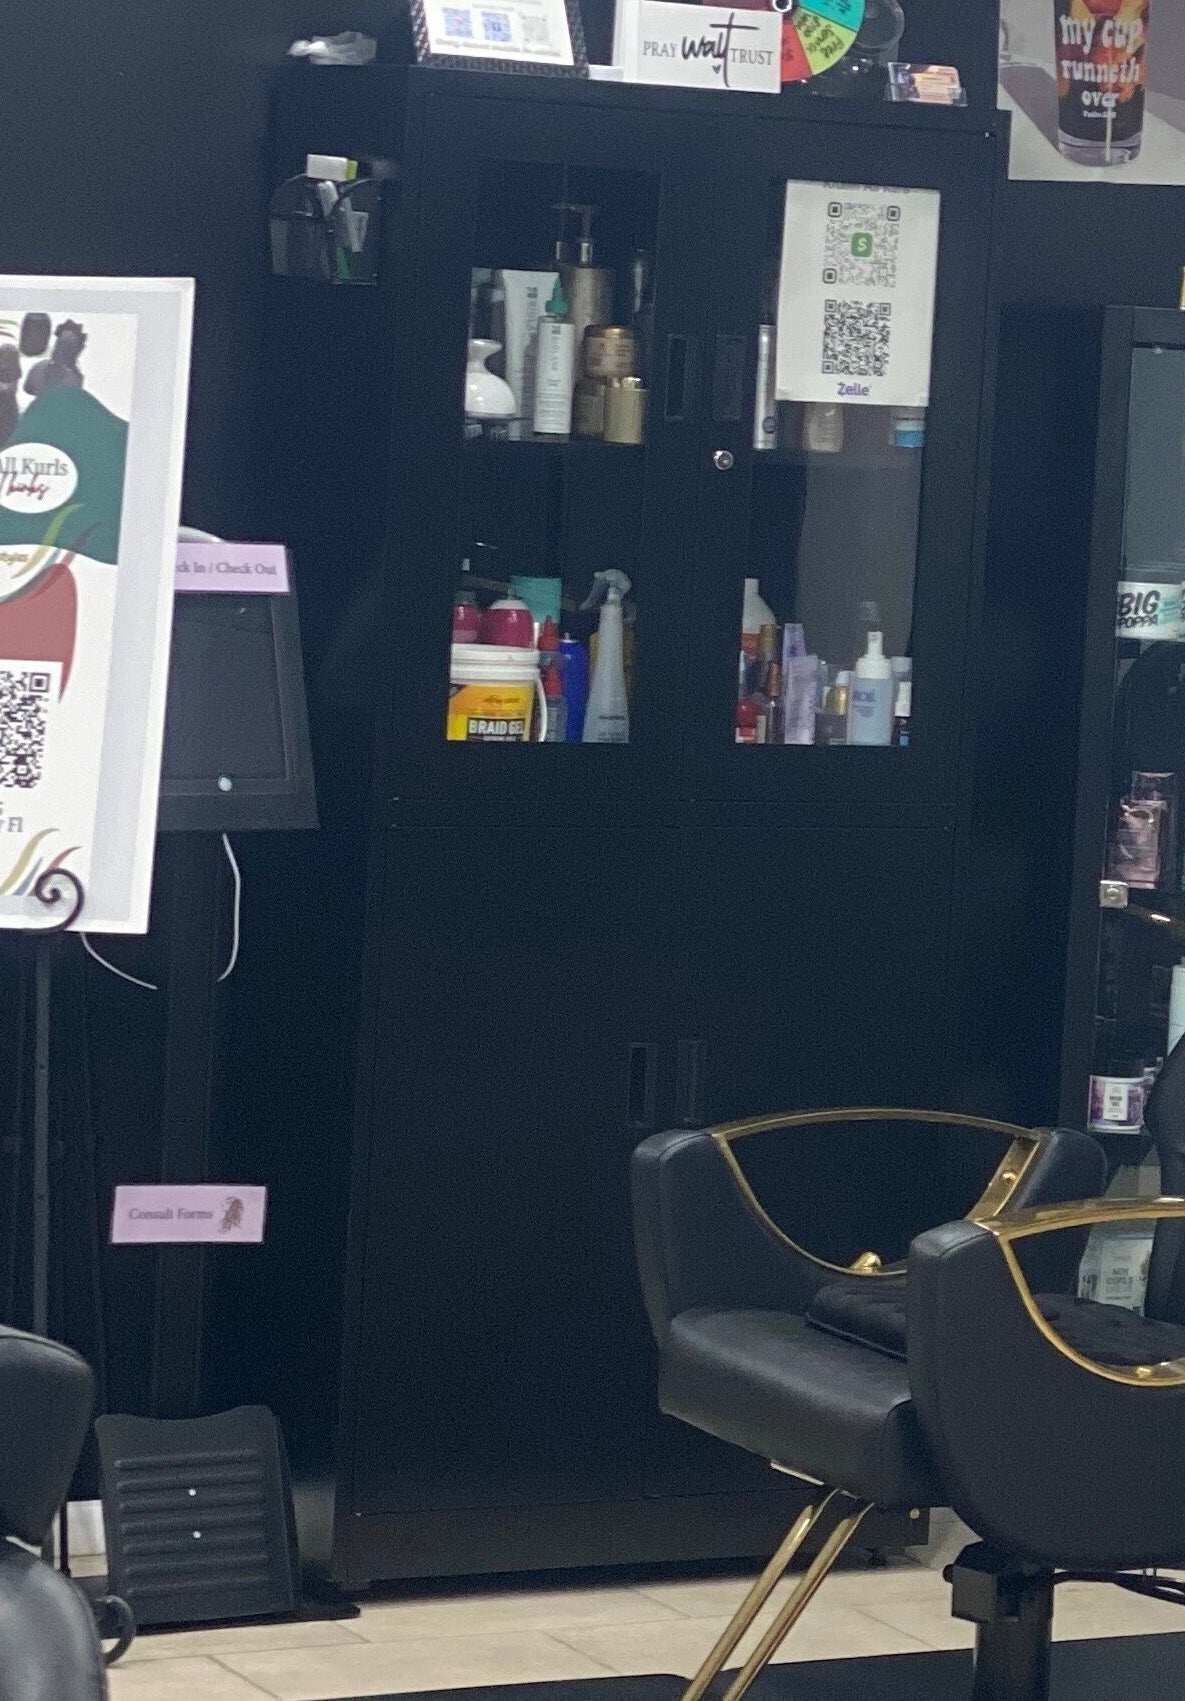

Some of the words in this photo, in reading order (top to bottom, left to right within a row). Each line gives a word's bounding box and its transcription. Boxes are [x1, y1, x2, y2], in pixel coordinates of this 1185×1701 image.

[1059, 14, 1096, 54] my
[1102, 18, 1144, 57] cup
[642, 41, 678, 58] PRAY
[682, 12, 760, 87] wait
[730, 48, 774, 66] TRUST
[1061, 57, 1140, 83] runneth
[1081, 90, 1120, 107] over
[837, 381, 870, 396] Zelle
[21, 458, 68, 476] Kurls
[216, 562, 252, 574] Check
[255, 563, 277, 575] Out
[1118, 590, 1161, 616] BIG
[468, 719, 508, 735] BRAID
[129, 1207, 173, 1220] Consult
[177, 1207, 214, 1220] Forms
